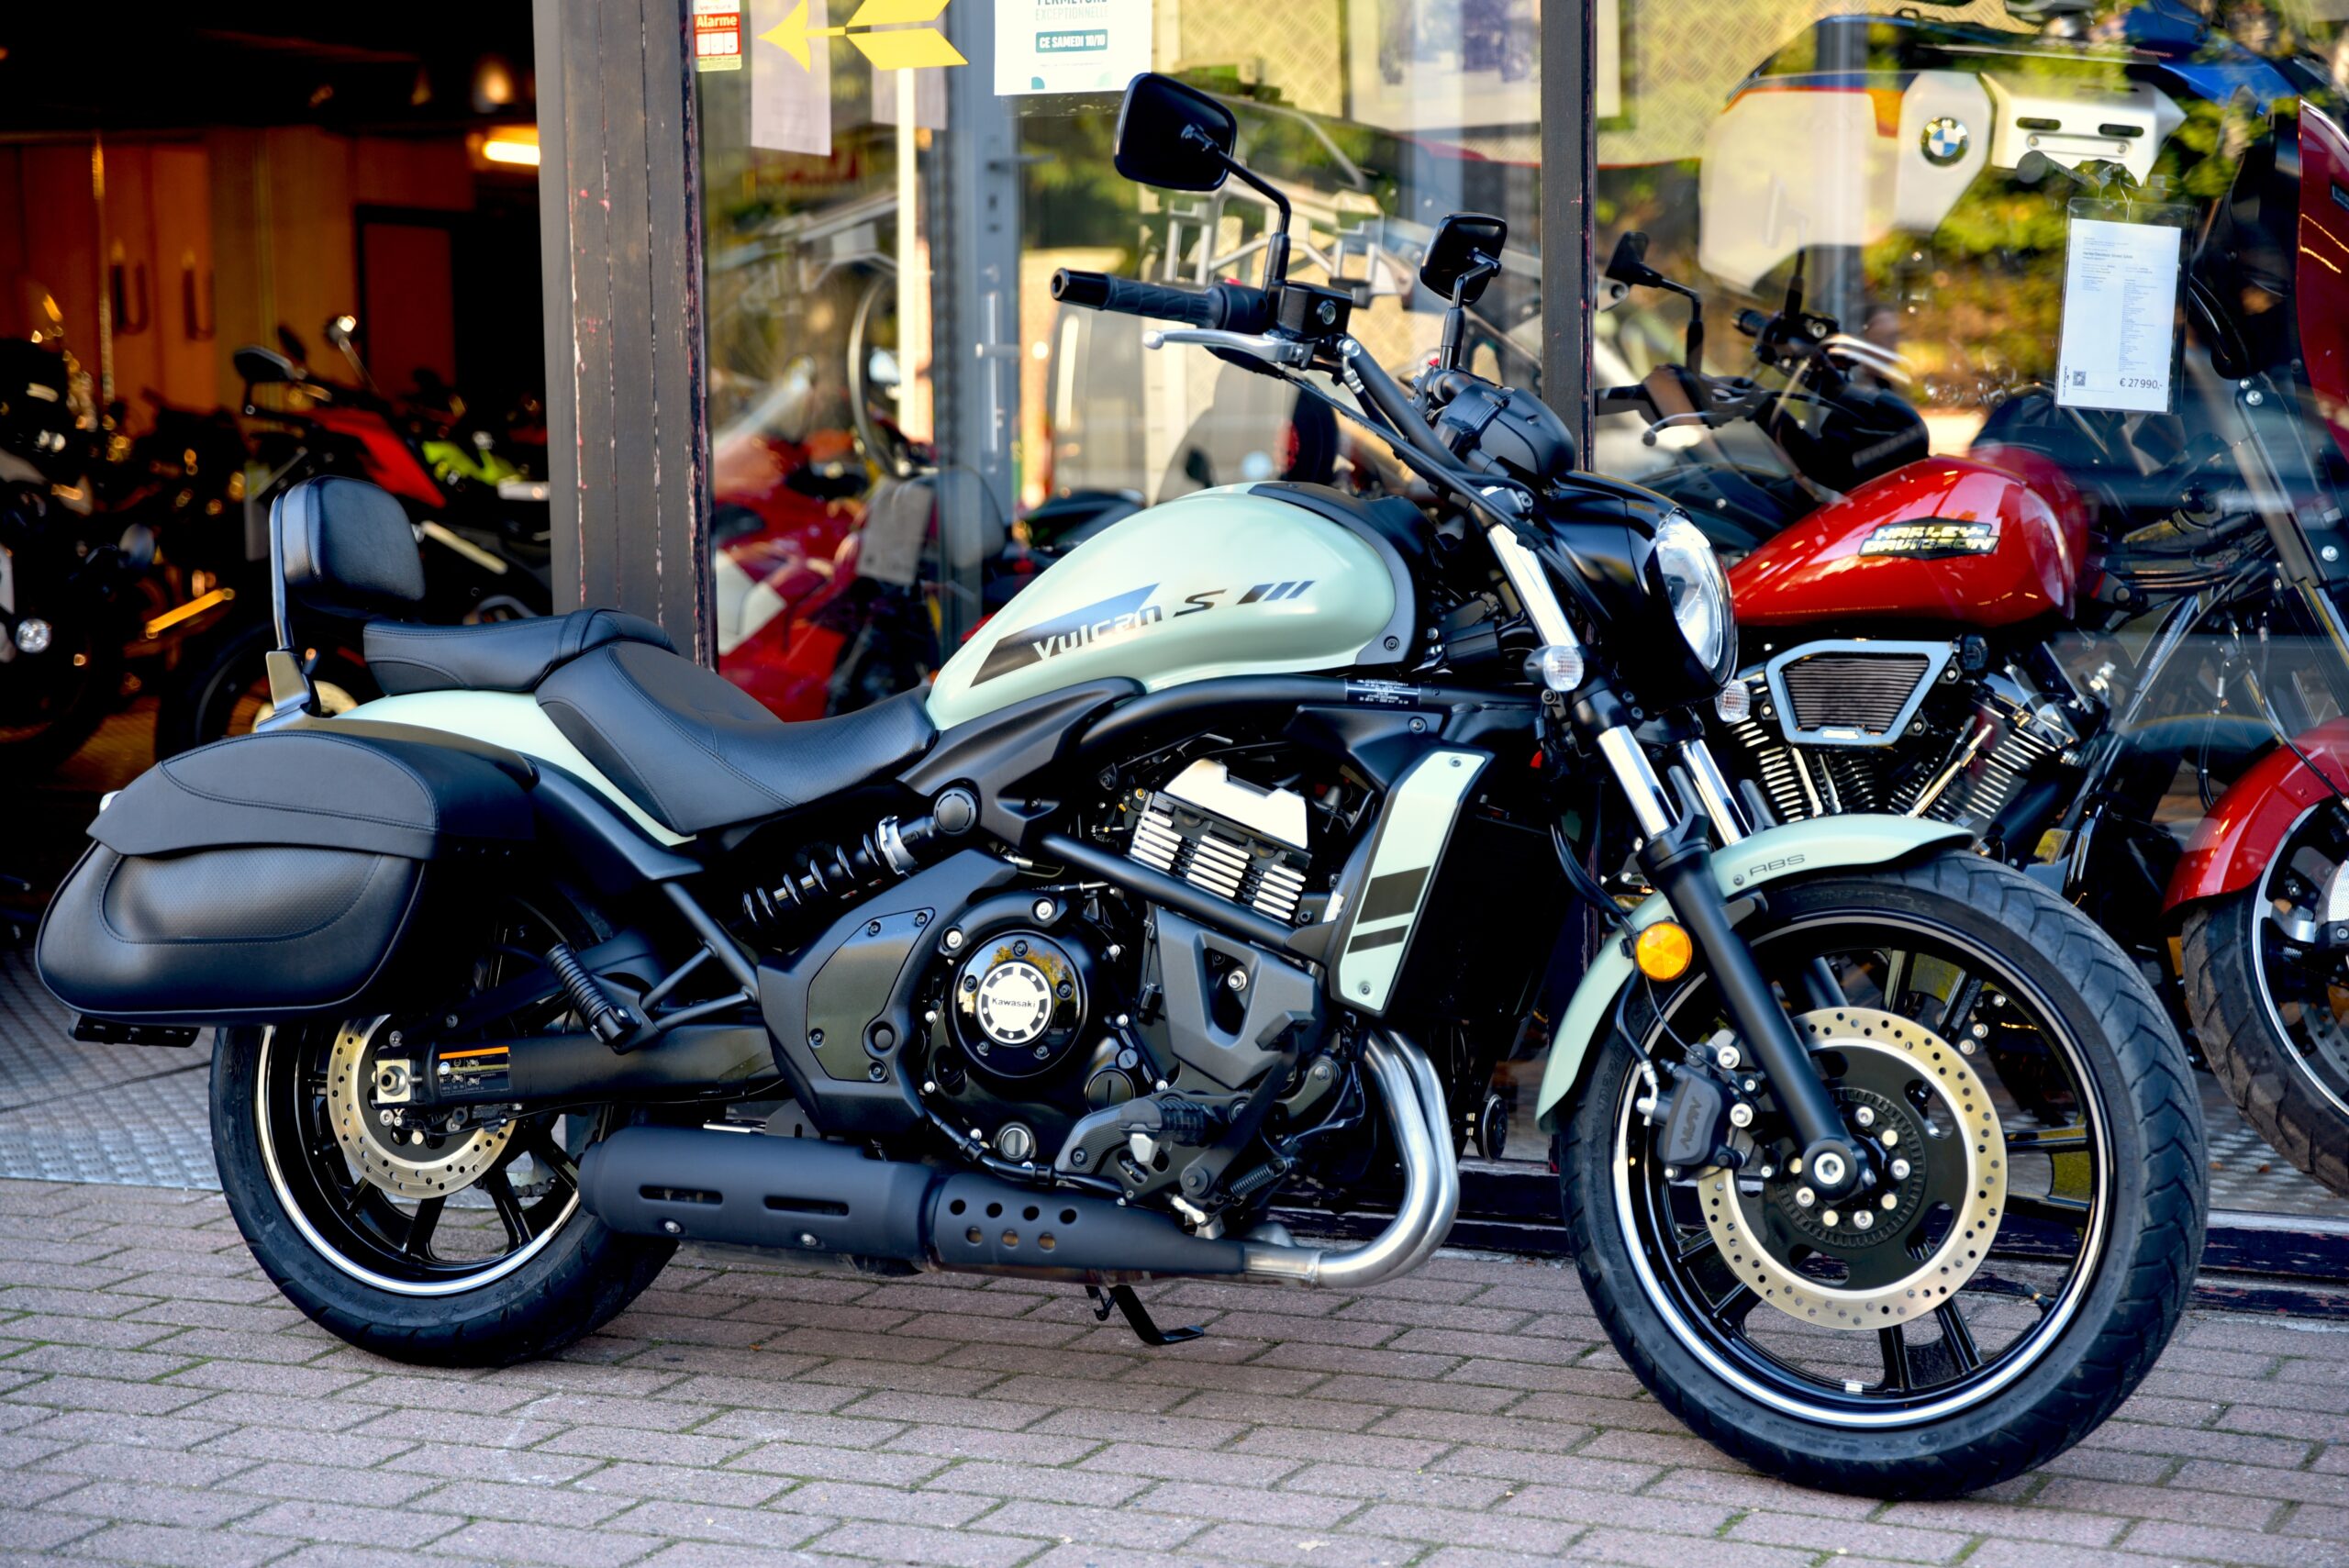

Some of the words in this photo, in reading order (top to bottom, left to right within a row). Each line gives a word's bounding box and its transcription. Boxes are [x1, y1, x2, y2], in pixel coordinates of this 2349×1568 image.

[1035, 6, 1108, 21] EXCEPTIONNELLE
[696, 15, 738, 28] Alarme
[1039, 37, 1051, 48] CE
[1052, 35, 1085, 48] SAMEDI
[1033, 605, 1163, 662] Vulcan
[1173, 588, 1228, 617] S
[1749, 854, 1805, 876] ABS
[992, 997, 1036, 1008] Kawasaki
